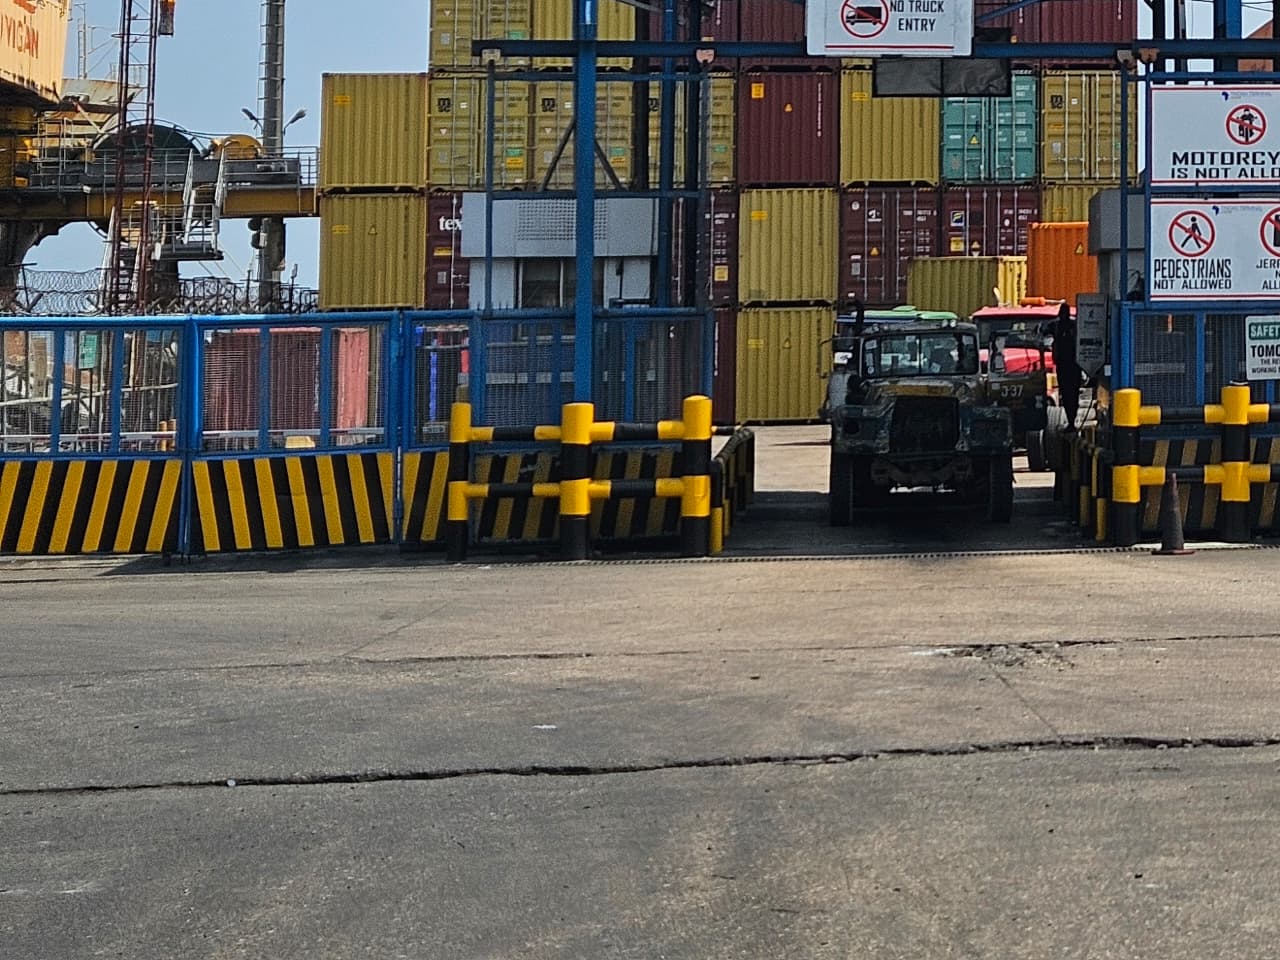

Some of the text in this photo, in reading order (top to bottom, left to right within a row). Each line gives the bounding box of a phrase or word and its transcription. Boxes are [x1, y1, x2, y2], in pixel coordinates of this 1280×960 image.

[889, 0, 944, 12] NO TRUCK
[898, 18, 936, 31] ENTRY
[1171, 167, 1188, 179] IS
[1195, 167, 1231, 179] NOT
[440, 216, 462, 230] tex
[1154, 259, 1231, 279] PEDESTRIANS
[1154, 279, 1232, 290] NOT ALLOWED
